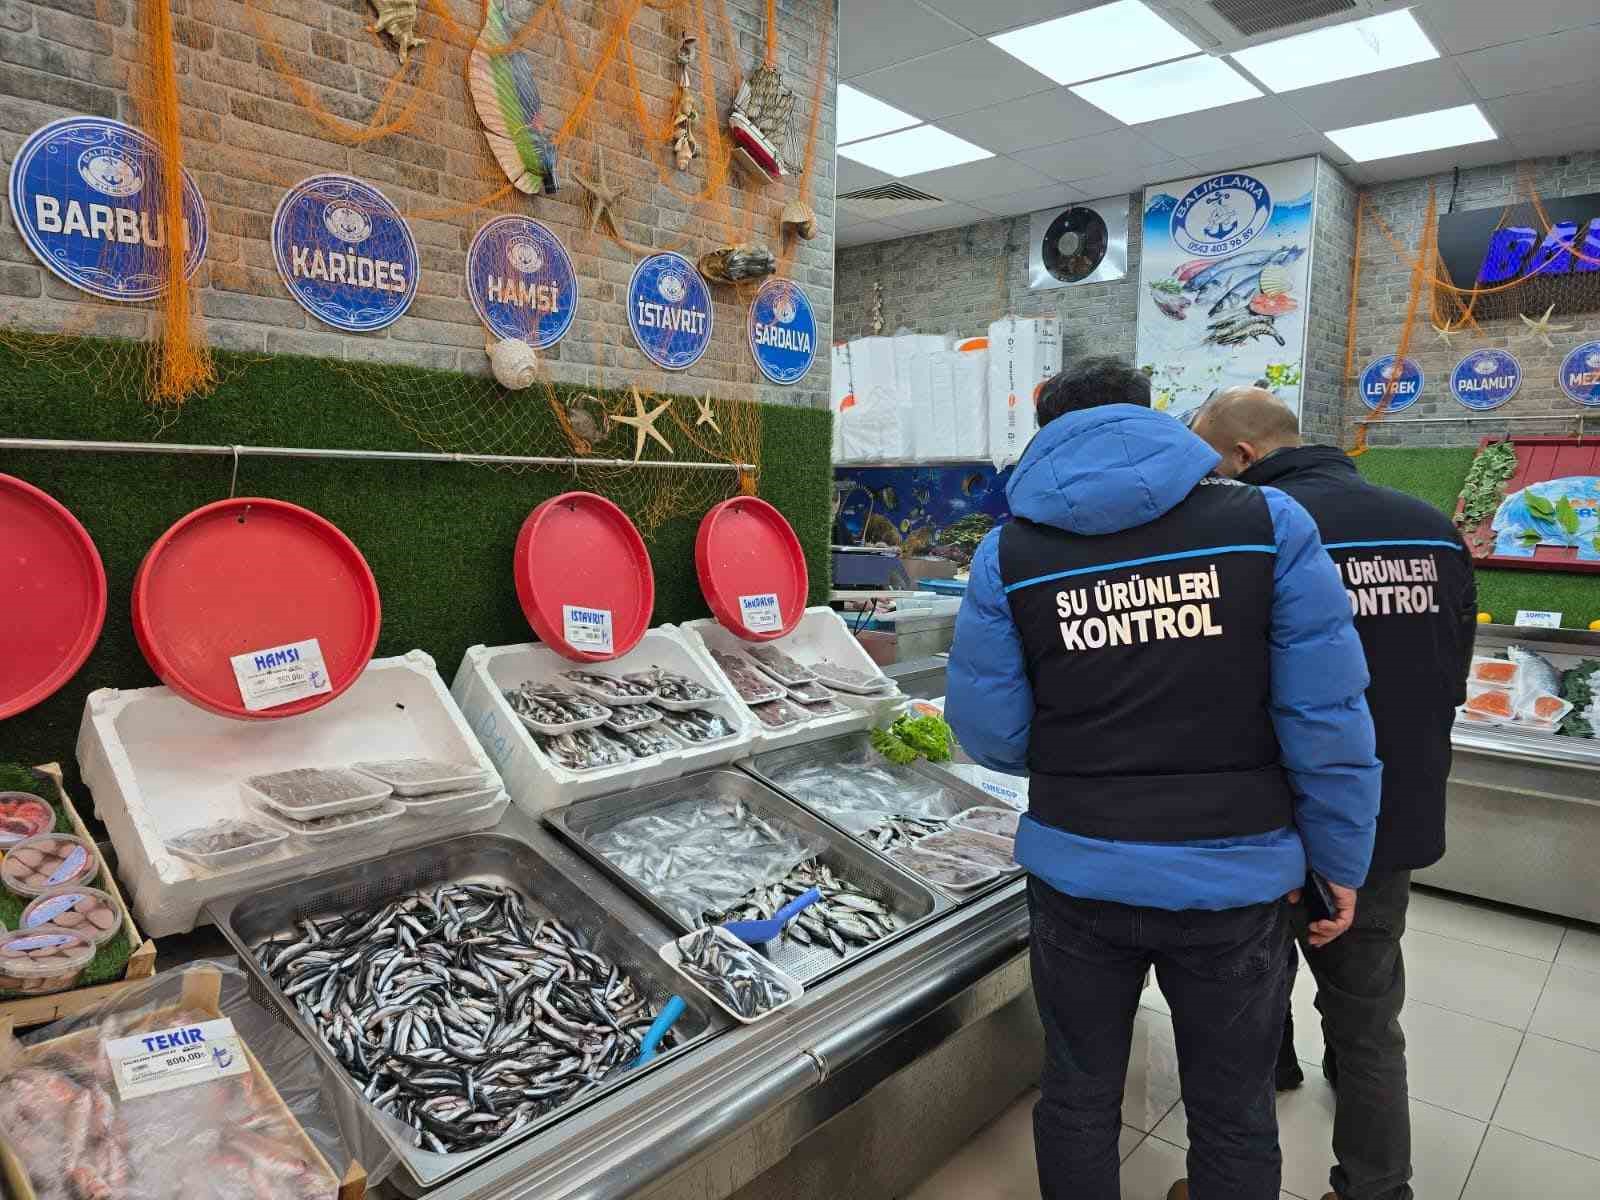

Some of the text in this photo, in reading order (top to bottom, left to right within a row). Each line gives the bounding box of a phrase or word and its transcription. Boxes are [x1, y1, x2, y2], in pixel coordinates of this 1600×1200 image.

[1176, 176, 1264, 218] BALIKLAMA
[36, 195, 190, 251] BARBU
[291, 245, 406, 293] KARİDES
[488, 275, 560, 313] HAMSİ
[638, 295, 706, 335] İSTAVRİT
[755, 323, 810, 354] SARDALYA
[1458, 375, 1516, 391] PALAMUT
[1347, 553, 1438, 585] ÜRÜNLERİ
[1056, 564, 1220, 618] SU ÜRÜNLERİ
[1060, 603, 1222, 651] KONTROL
[142, 1028, 206, 1052] TEKİR
